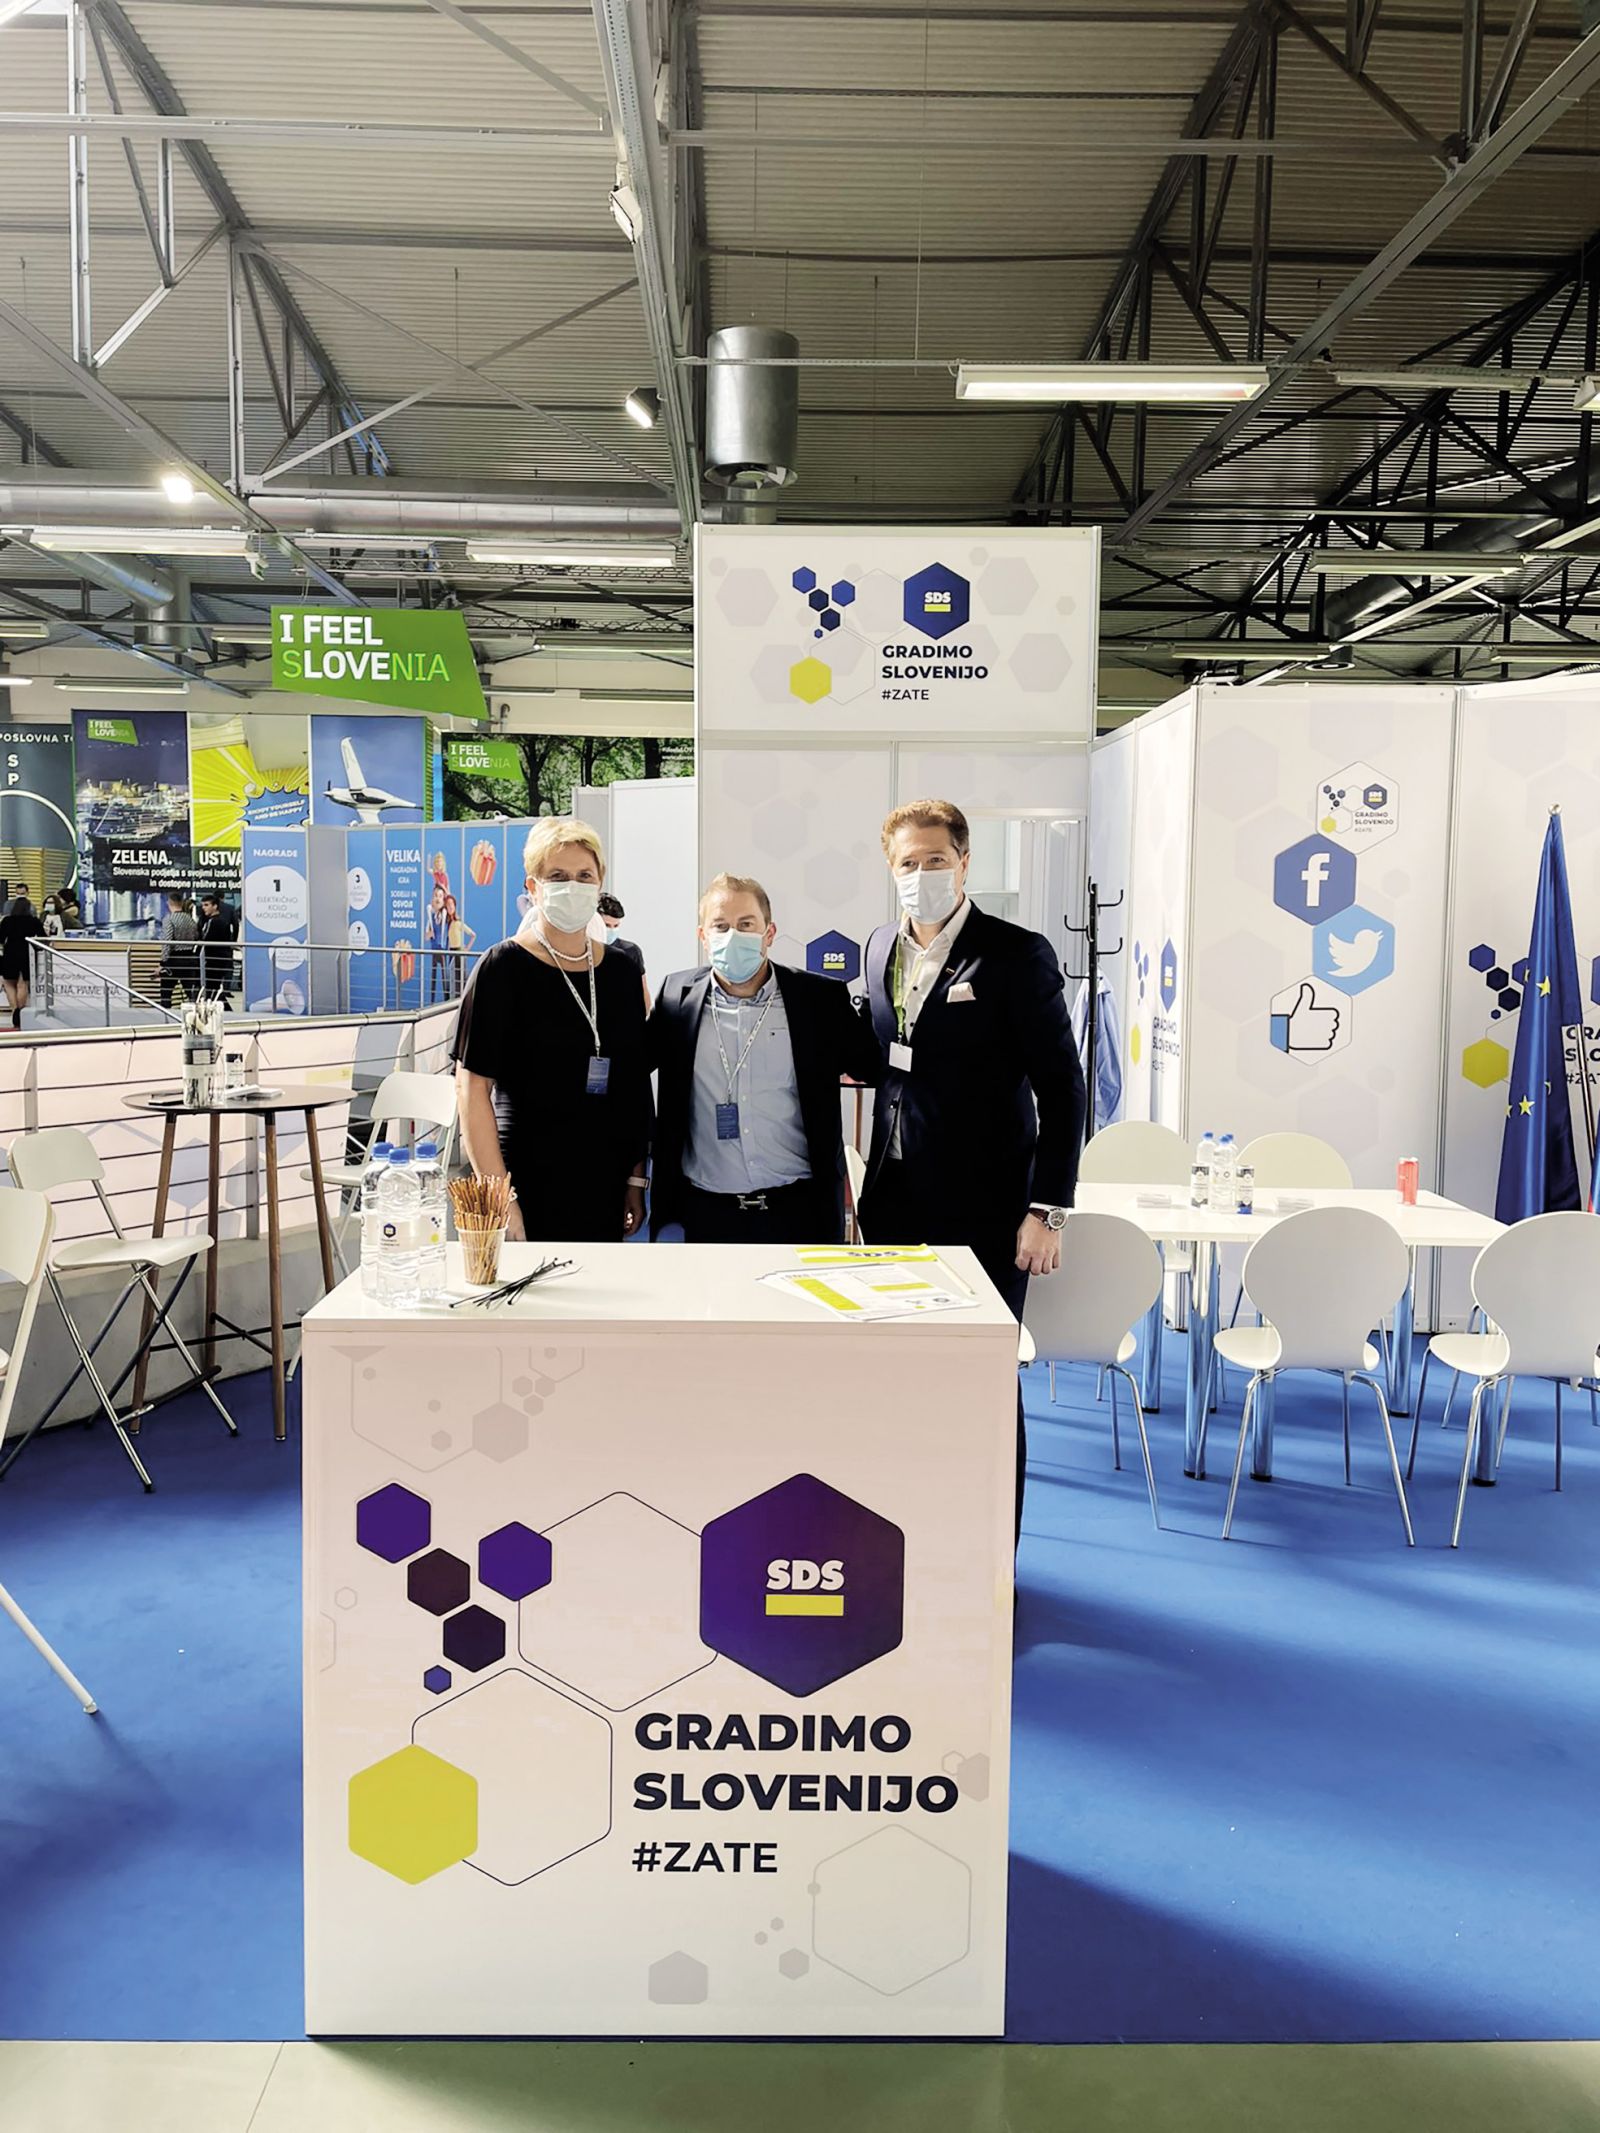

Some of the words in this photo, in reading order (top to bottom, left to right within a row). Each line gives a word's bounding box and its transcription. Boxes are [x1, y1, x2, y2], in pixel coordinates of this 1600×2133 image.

[924, 591, 951, 603] SDS
[279, 614, 294, 643] I
[303, 615, 384, 646] FEEL
[882, 645, 973, 658] GRADIMO
[282, 649, 450, 682] SLOVENIA
[881, 665, 988, 679] SLOVENIJO
[881, 689, 929, 700] #ZATE
[451, 744, 456, 755] I
[459, 745, 488, 756] FEEL
[112, 849, 173, 865] ZELENA.
[253, 849, 298, 858] NAGRADE
[386, 849, 421, 863] VELIKA
[112, 866, 150, 876] Slovenska
[273, 879, 281, 892] 1
[823, 952, 845, 962] SDS
[766, 1559, 845, 1591] SDS
[634, 1712, 912, 1753] GRADIMO
[632, 1773, 959, 1813] SLOVENIJO
[631, 1842, 778, 1873] #ZATE
